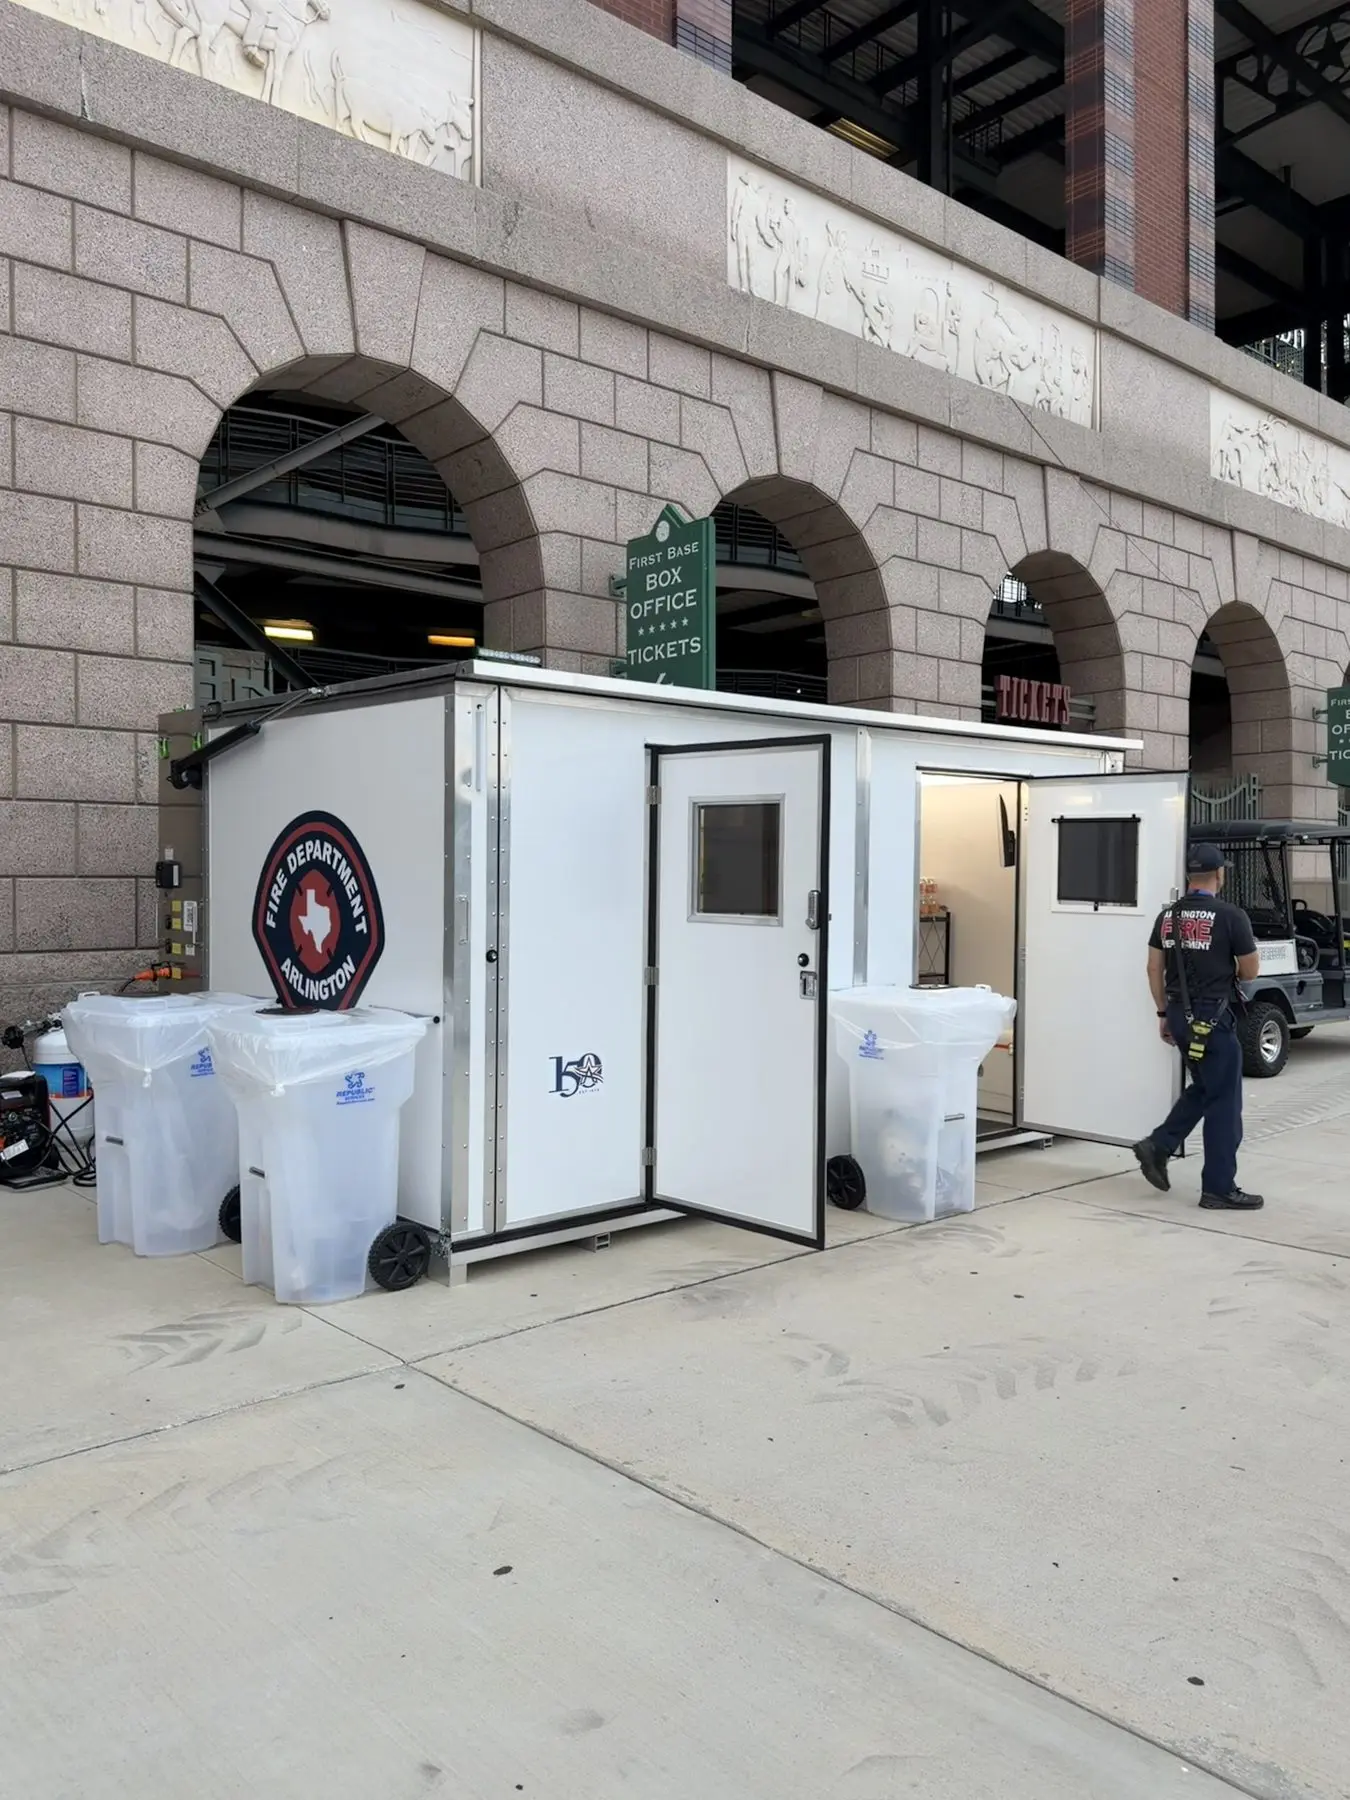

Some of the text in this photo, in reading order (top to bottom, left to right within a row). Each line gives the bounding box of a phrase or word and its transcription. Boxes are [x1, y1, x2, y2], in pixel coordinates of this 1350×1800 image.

[629, 541, 700, 570] FIRST BASE
[646, 566, 682, 591] BOX
[630, 588, 697, 619] OFFICE
[628, 636, 701, 665] TICKETS
[998, 674, 1071, 725] TICKETS
[266, 839, 368, 935] FIRE DEPARTMENT
[1160, 917, 1214, 943] FRE
[280, 955, 356, 1001] ARLINGTON
